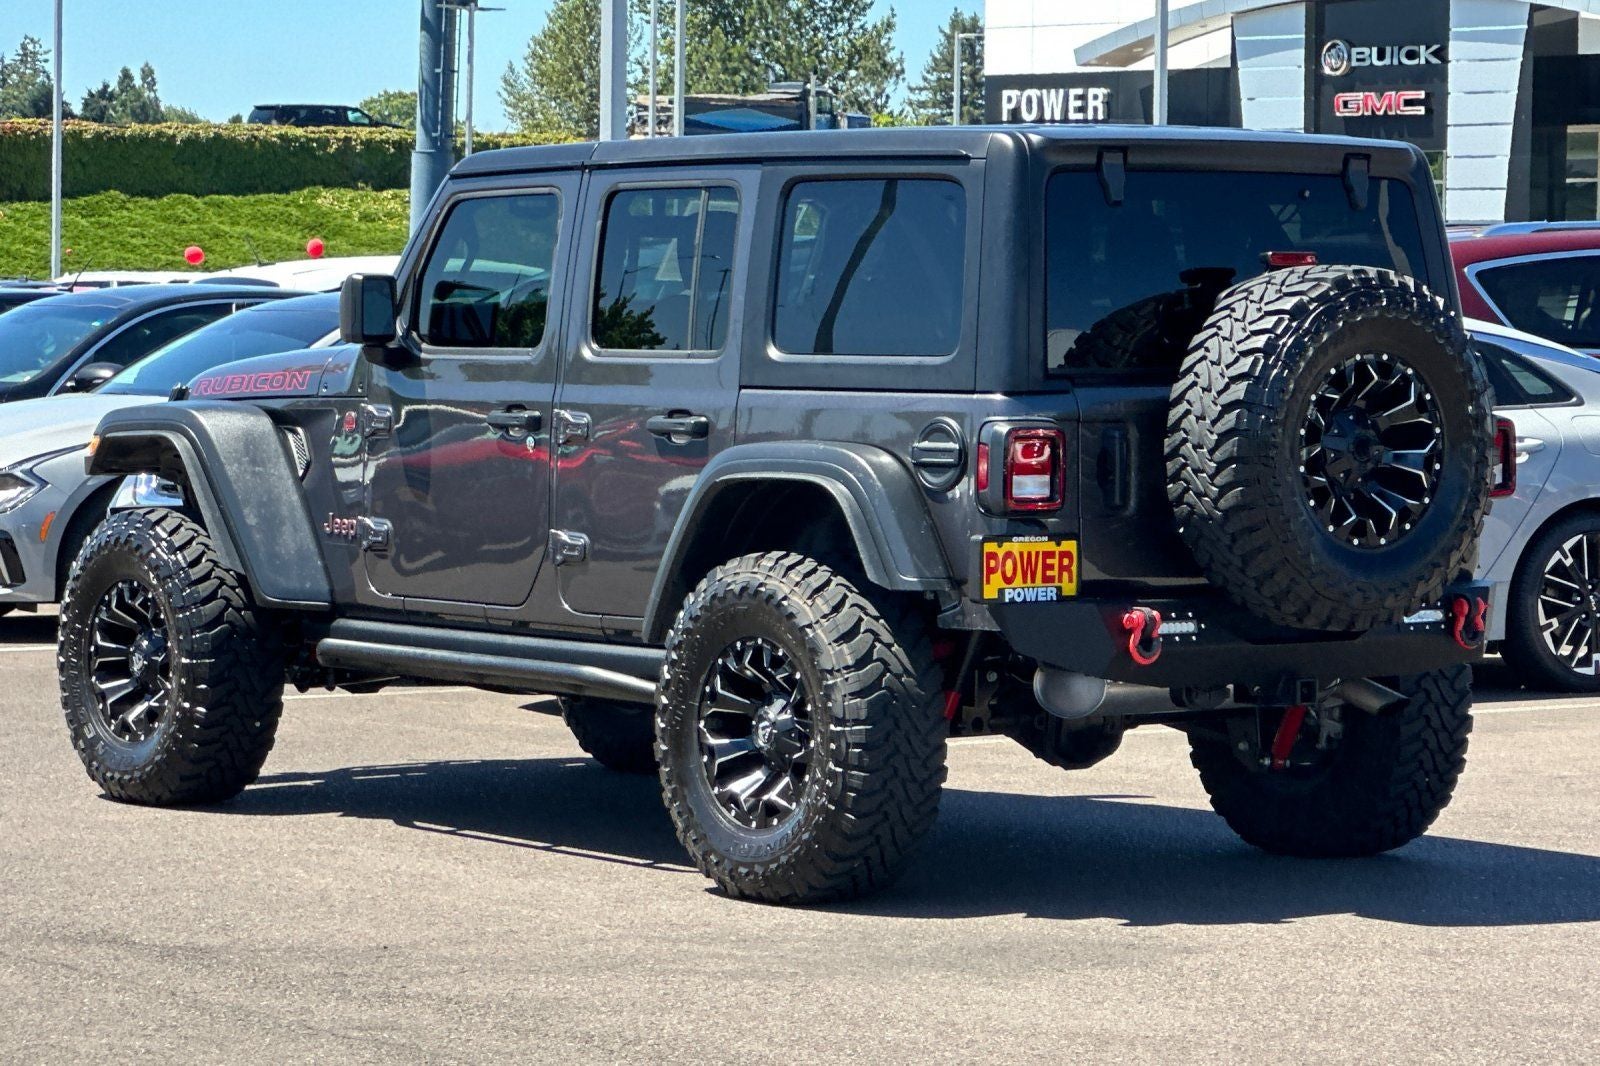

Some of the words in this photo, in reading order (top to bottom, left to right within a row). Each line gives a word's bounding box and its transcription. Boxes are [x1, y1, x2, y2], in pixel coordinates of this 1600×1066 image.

[1351, 44, 1442, 67] BUICK
[1001, 87, 1108, 122] POWER
[1334, 90, 1426, 117] GMC
[193, 370, 311, 396] RUBICON
[323, 512, 357, 540] Jeep
[985, 550, 1074, 585] POWER
[1004, 587, 1057, 602] POWER
